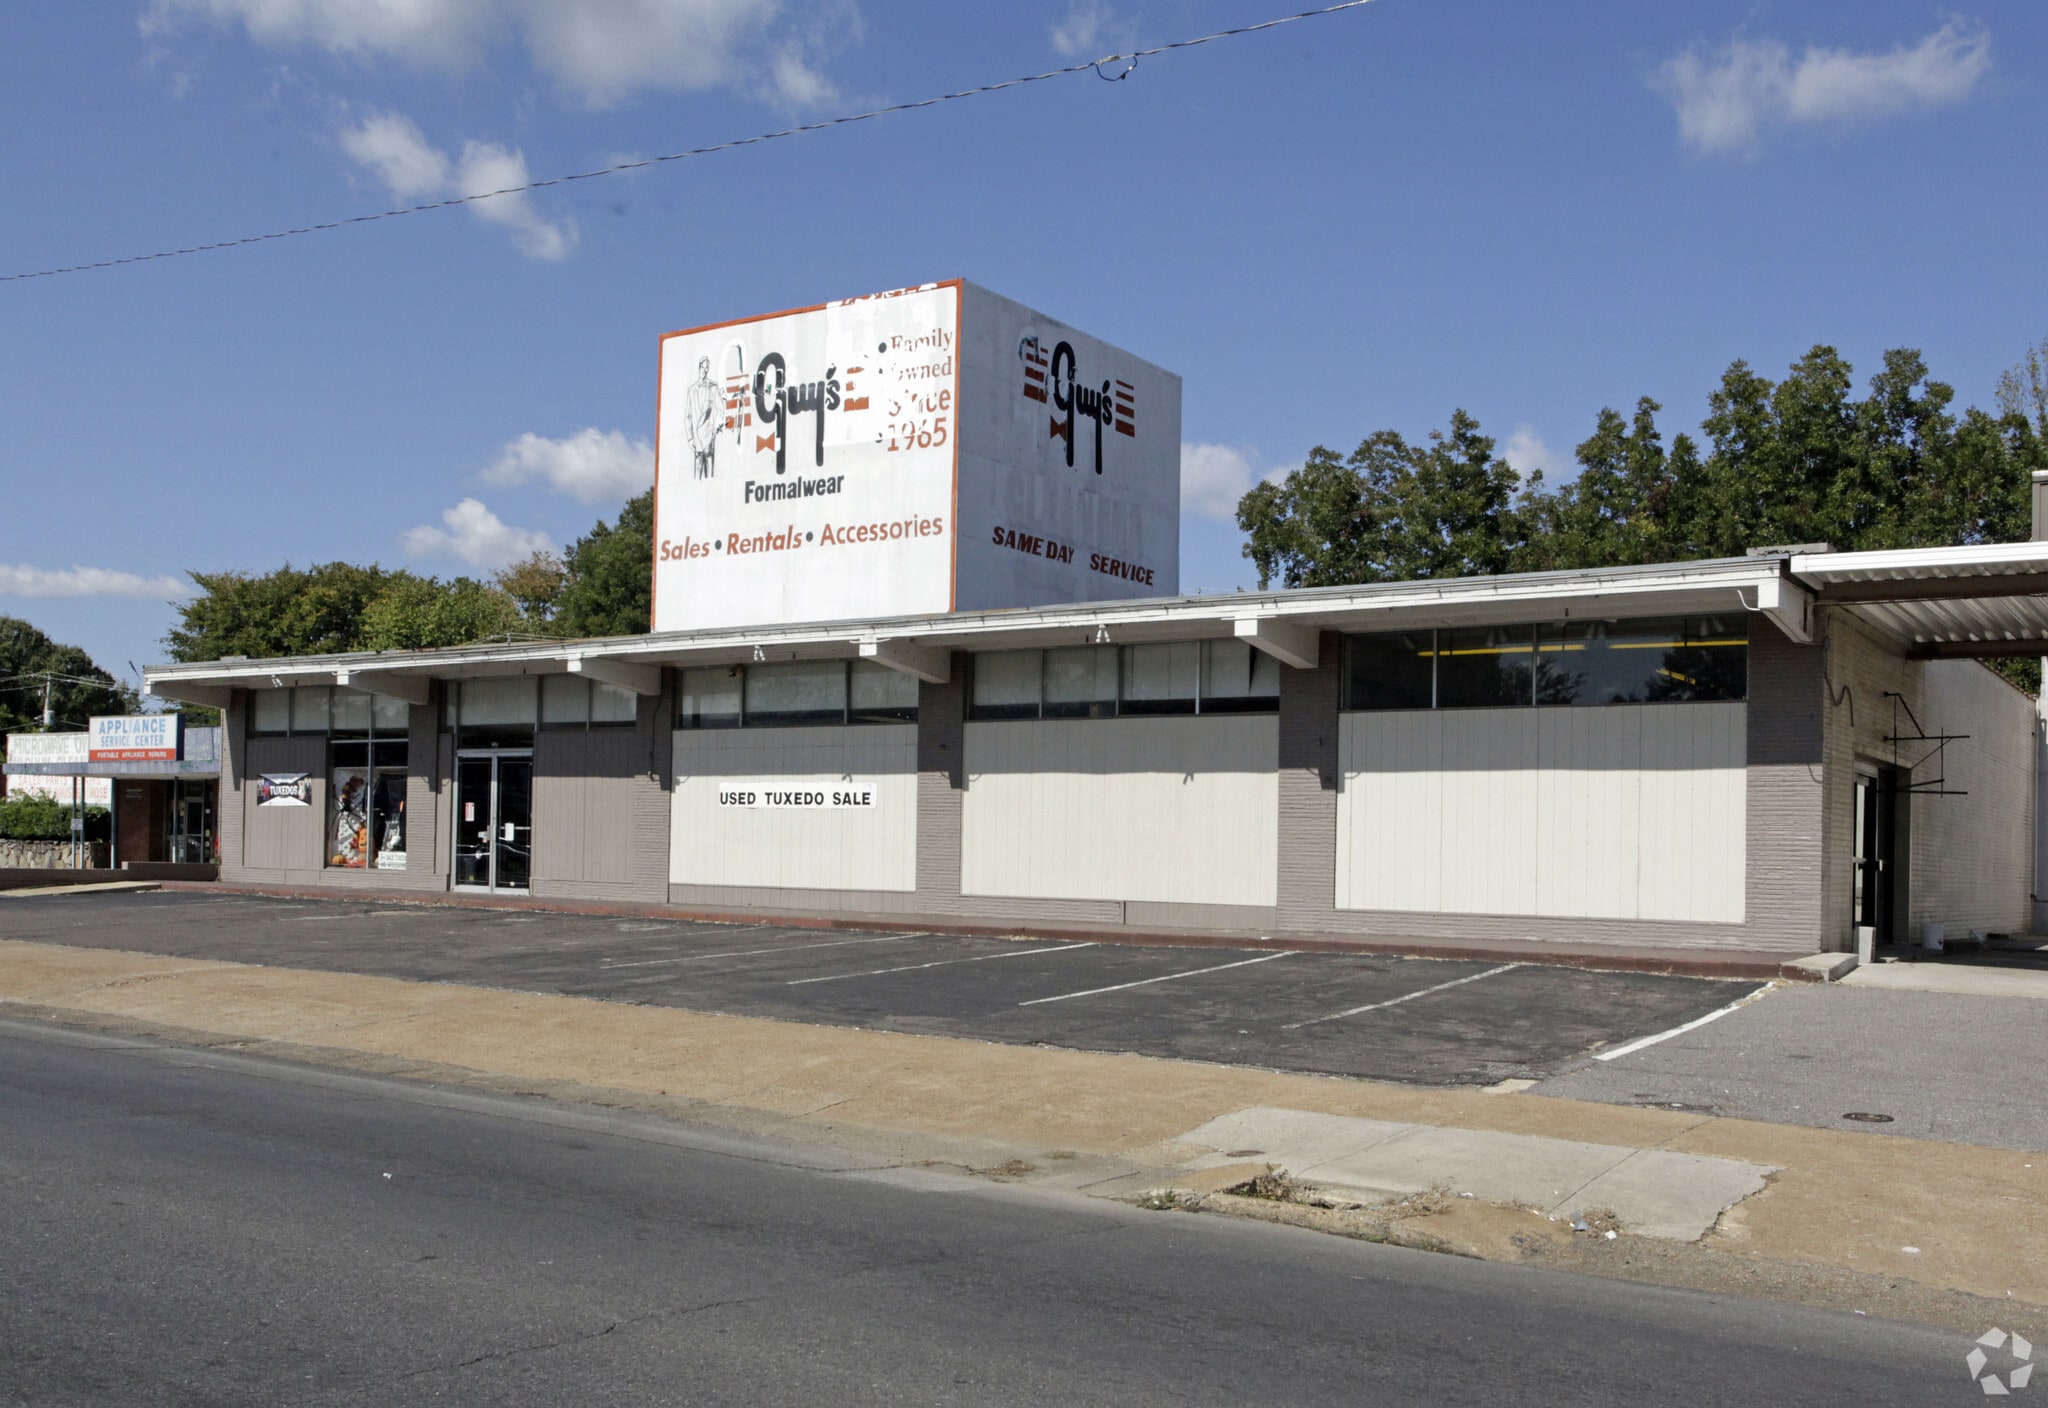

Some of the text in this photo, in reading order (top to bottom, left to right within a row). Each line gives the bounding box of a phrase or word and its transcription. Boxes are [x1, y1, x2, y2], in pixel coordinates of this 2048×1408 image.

[891, 328, 953, 352] Family
[1051, 341, 1113, 475] Guy's
[888, 417, 947, 452] 1965
[745, 475, 844, 504] Formalwear
[660, 514, 944, 561] Sales Rentals Accessories
[992, 526, 1155, 586] SAME DAY SERVICE
[98, 718, 166, 734] APPLIANCE
[14, 737, 69, 755] MICROWAVE
[100, 735, 164, 748] SERVICE CENTER
[97, 751, 119, 759] PORTABLE
[18, 775, 40, 786] SALES
[46, 776, 68, 787] PARTS
[90, 786, 108, 799] HOSE
[269, 785, 298, 796] TUXEDOS
[720, 792, 871, 806] USED TUXEDO SALE
